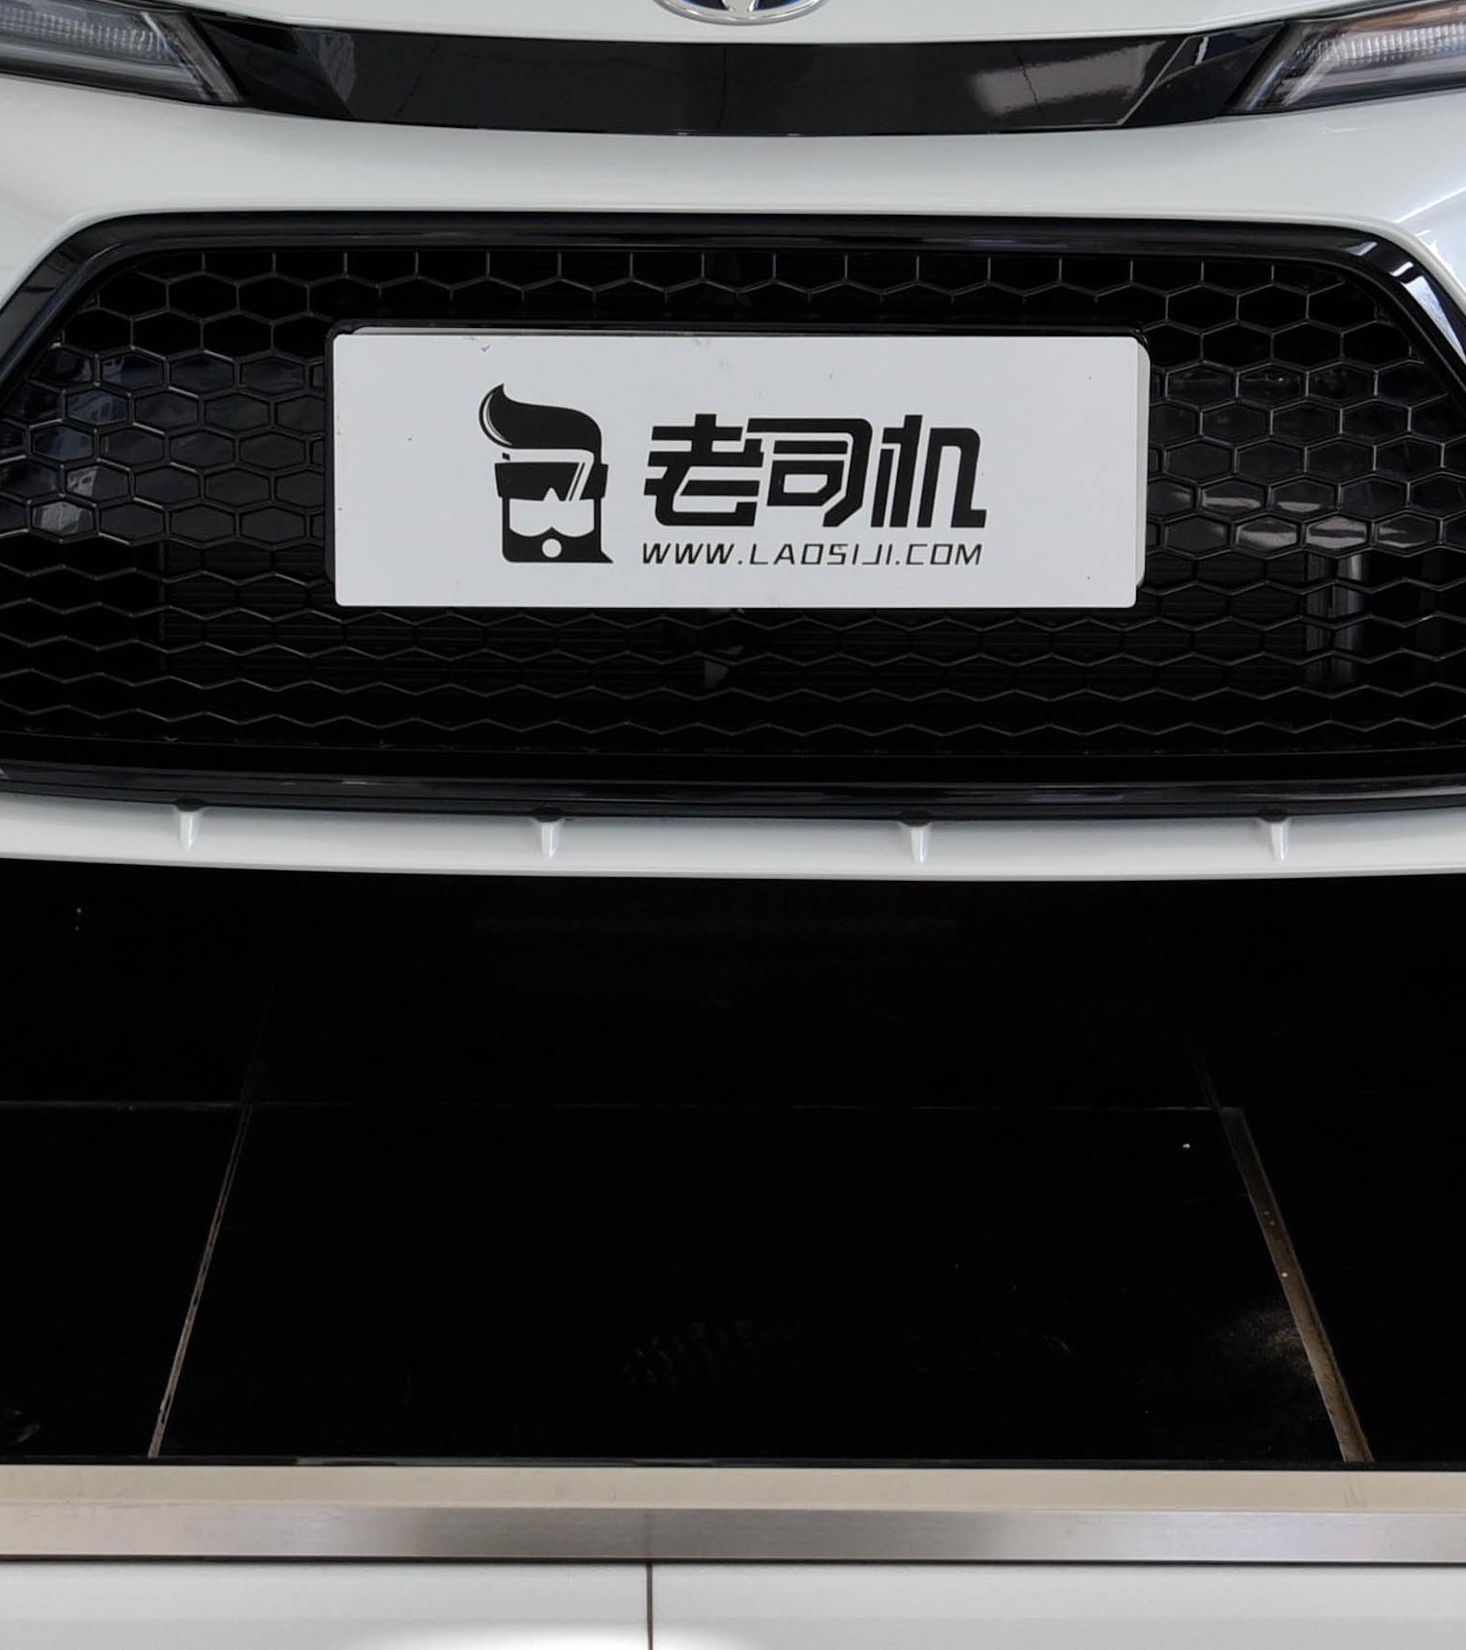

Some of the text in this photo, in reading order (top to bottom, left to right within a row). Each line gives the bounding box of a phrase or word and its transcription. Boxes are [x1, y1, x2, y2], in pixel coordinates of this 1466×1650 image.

[641, 413, 988, 529] 老司机
[640, 542, 984, 566] WWW.LAOSIJI.COM
